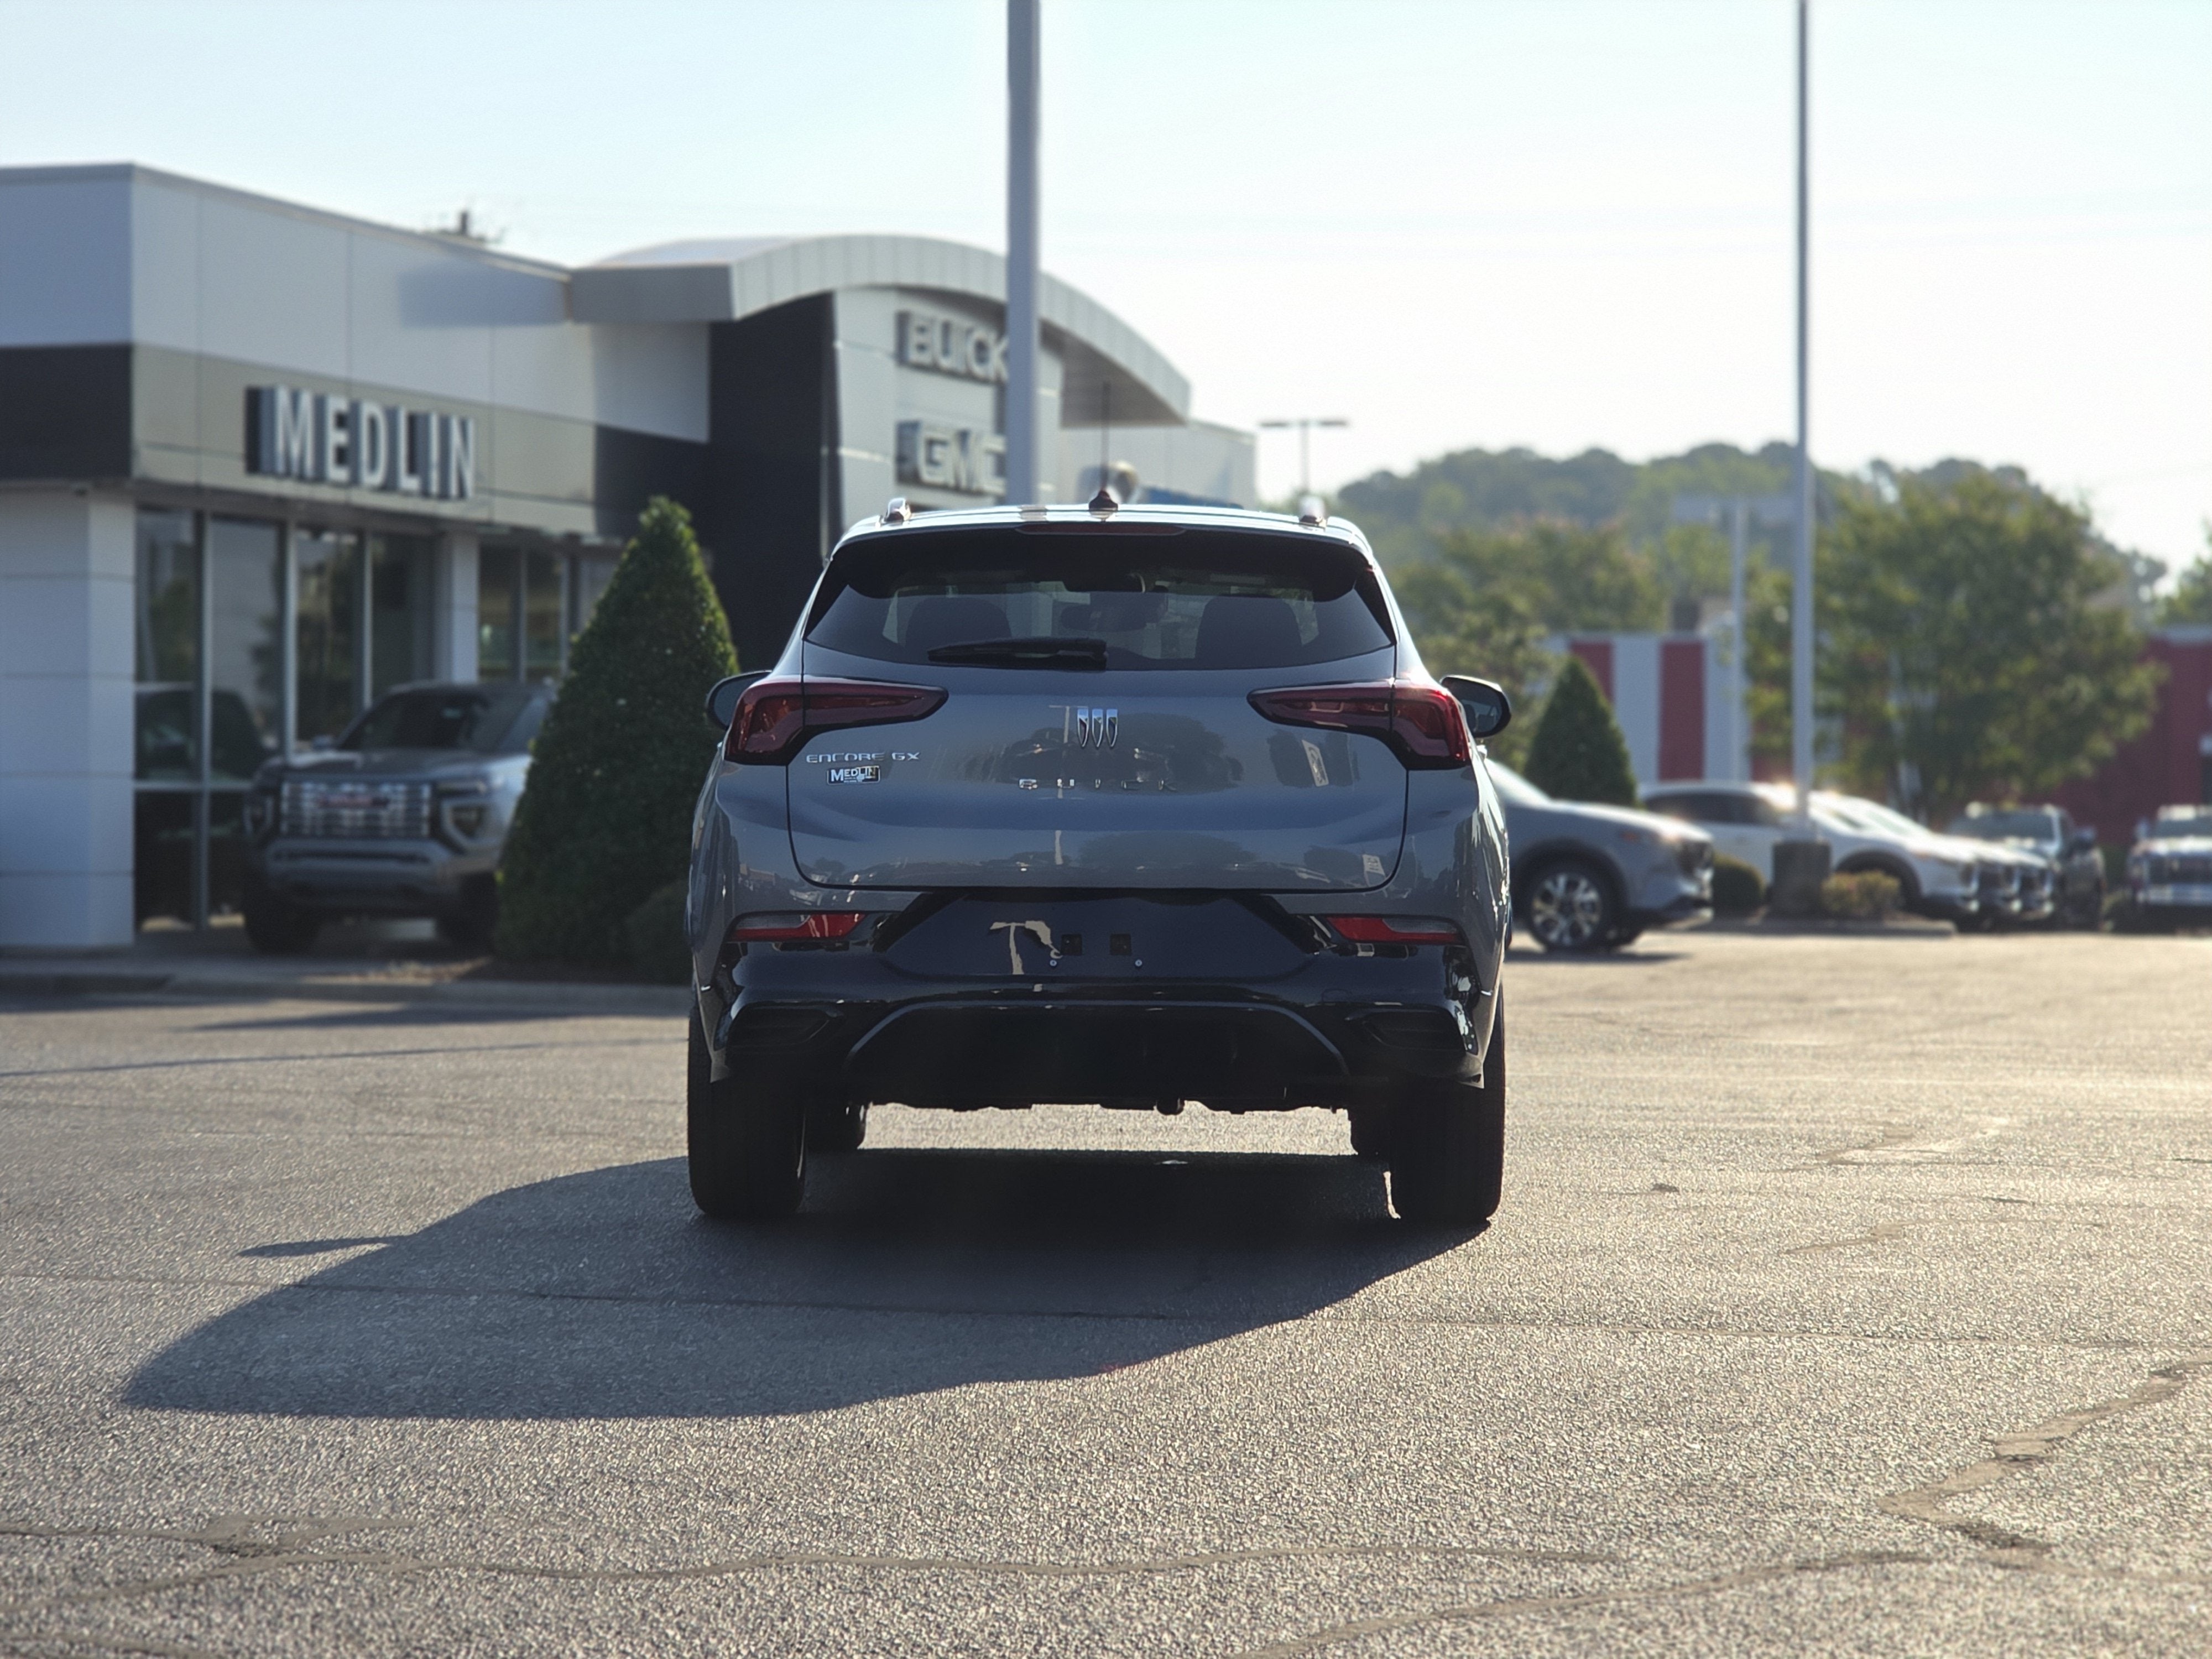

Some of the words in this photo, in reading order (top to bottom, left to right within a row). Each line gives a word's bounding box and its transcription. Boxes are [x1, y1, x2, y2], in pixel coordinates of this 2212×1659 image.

[274, 385, 475, 498] MEDLIN
[806, 752, 885, 764] ENCORE
[891, 752, 920, 761] GX
